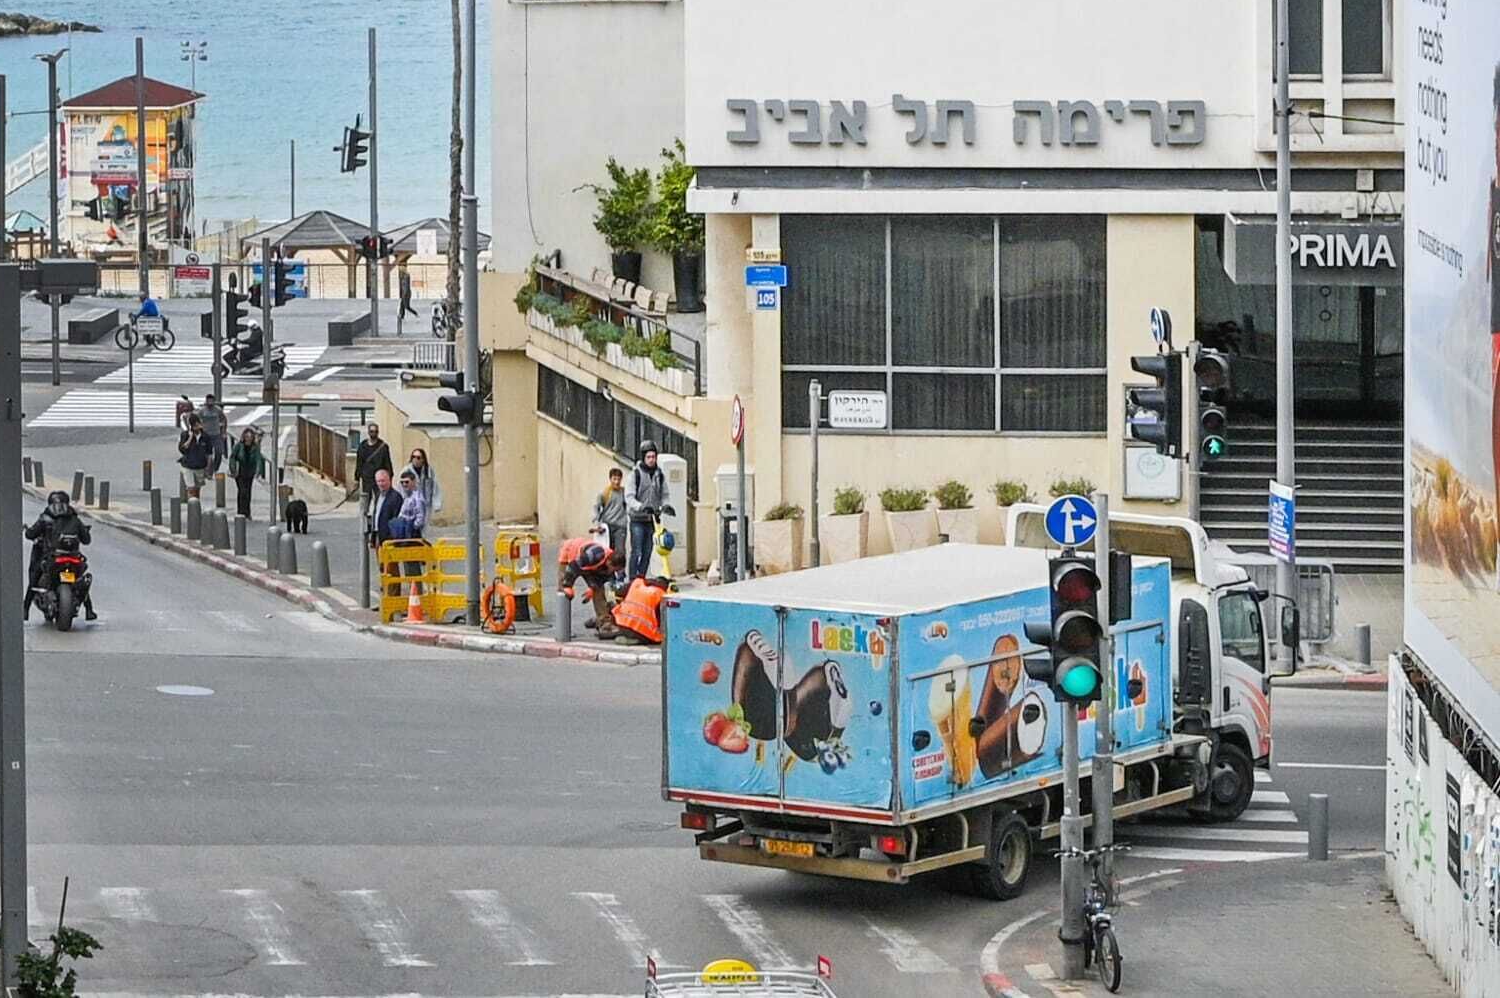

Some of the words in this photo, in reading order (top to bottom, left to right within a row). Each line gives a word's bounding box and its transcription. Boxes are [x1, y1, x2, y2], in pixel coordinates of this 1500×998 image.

[1418, 20, 1444, 65] needs
[726, 98, 868, 147] אביב
[892, 93, 976, 147] תל
[1012, 99, 1206, 147] פרימה
[1418, 76, 1448, 135] nothing
[1418, 126, 1431, 173] but
[1432, 144, 1448, 186] you
[758, 293, 775, 305] 105
